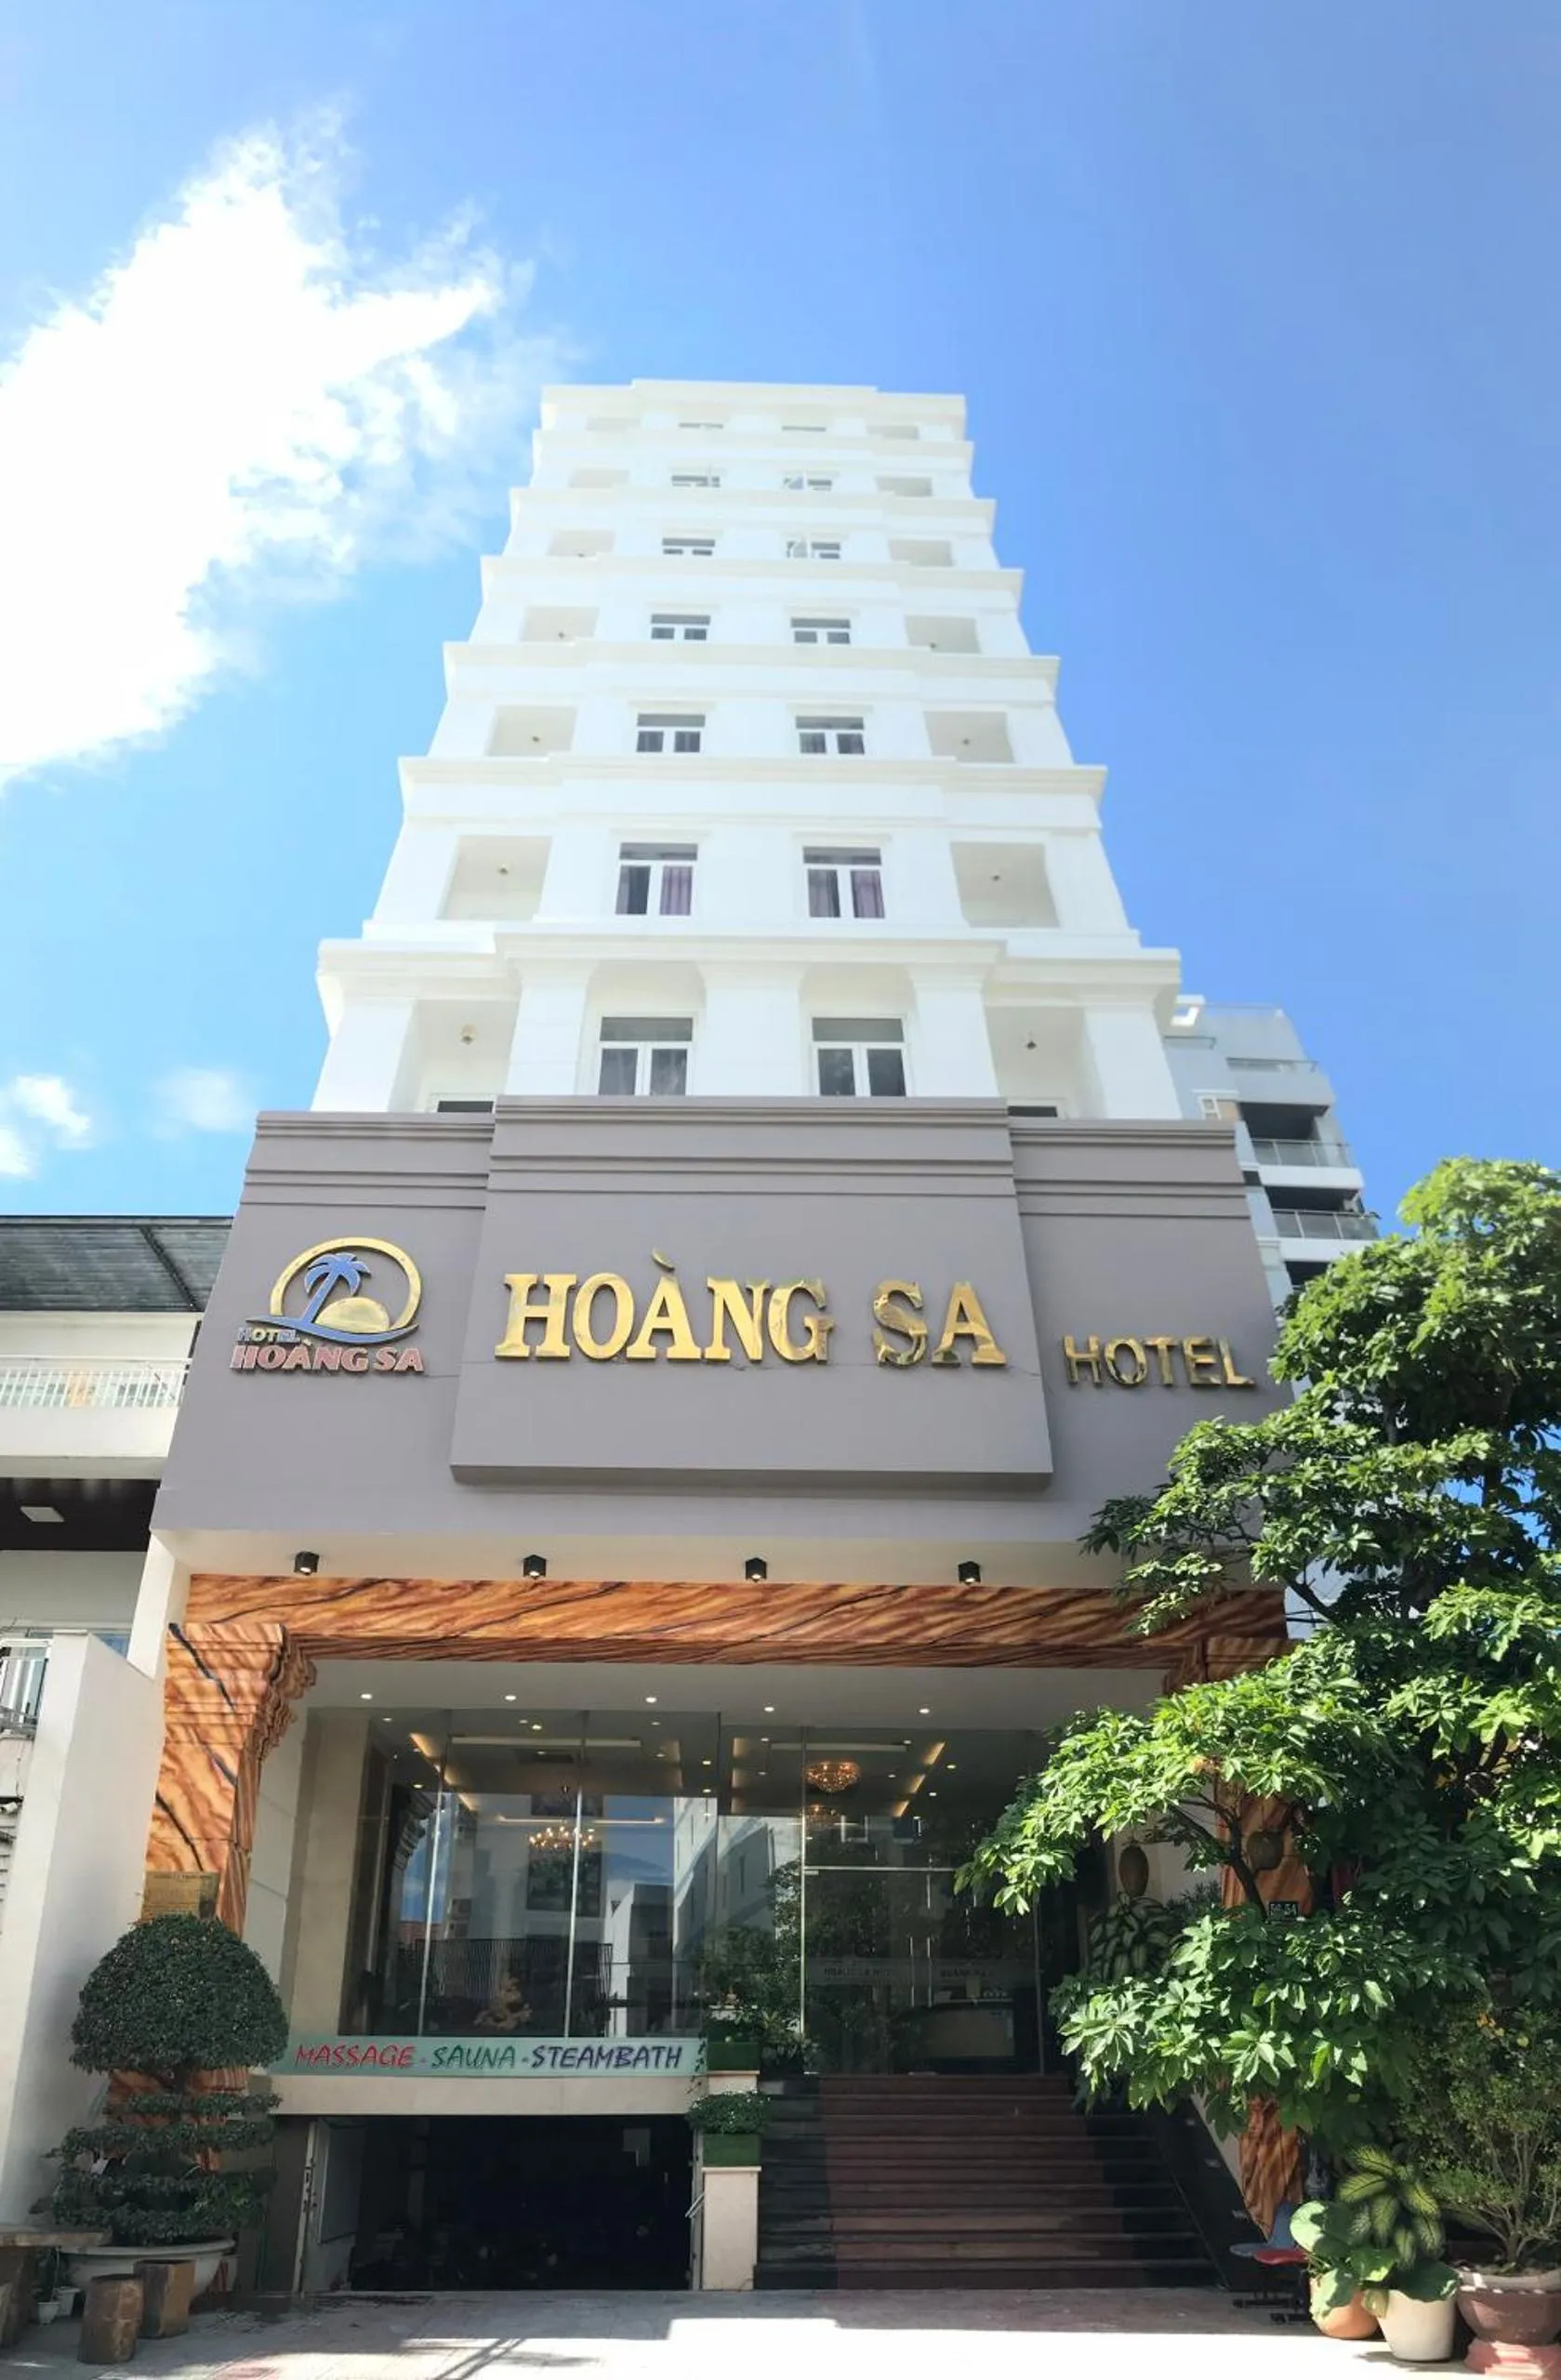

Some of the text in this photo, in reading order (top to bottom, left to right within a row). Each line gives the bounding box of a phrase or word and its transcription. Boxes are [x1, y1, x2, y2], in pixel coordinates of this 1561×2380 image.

[495, 1249, 1255, 1386] HOÀNG SA HOTEL
[238, 1327, 300, 1342] HOTEL
[230, 1339, 425, 1372] HOÀNG SA
[295, 2043, 683, 2069] MASSAGE SAUNA STEAMBATH
